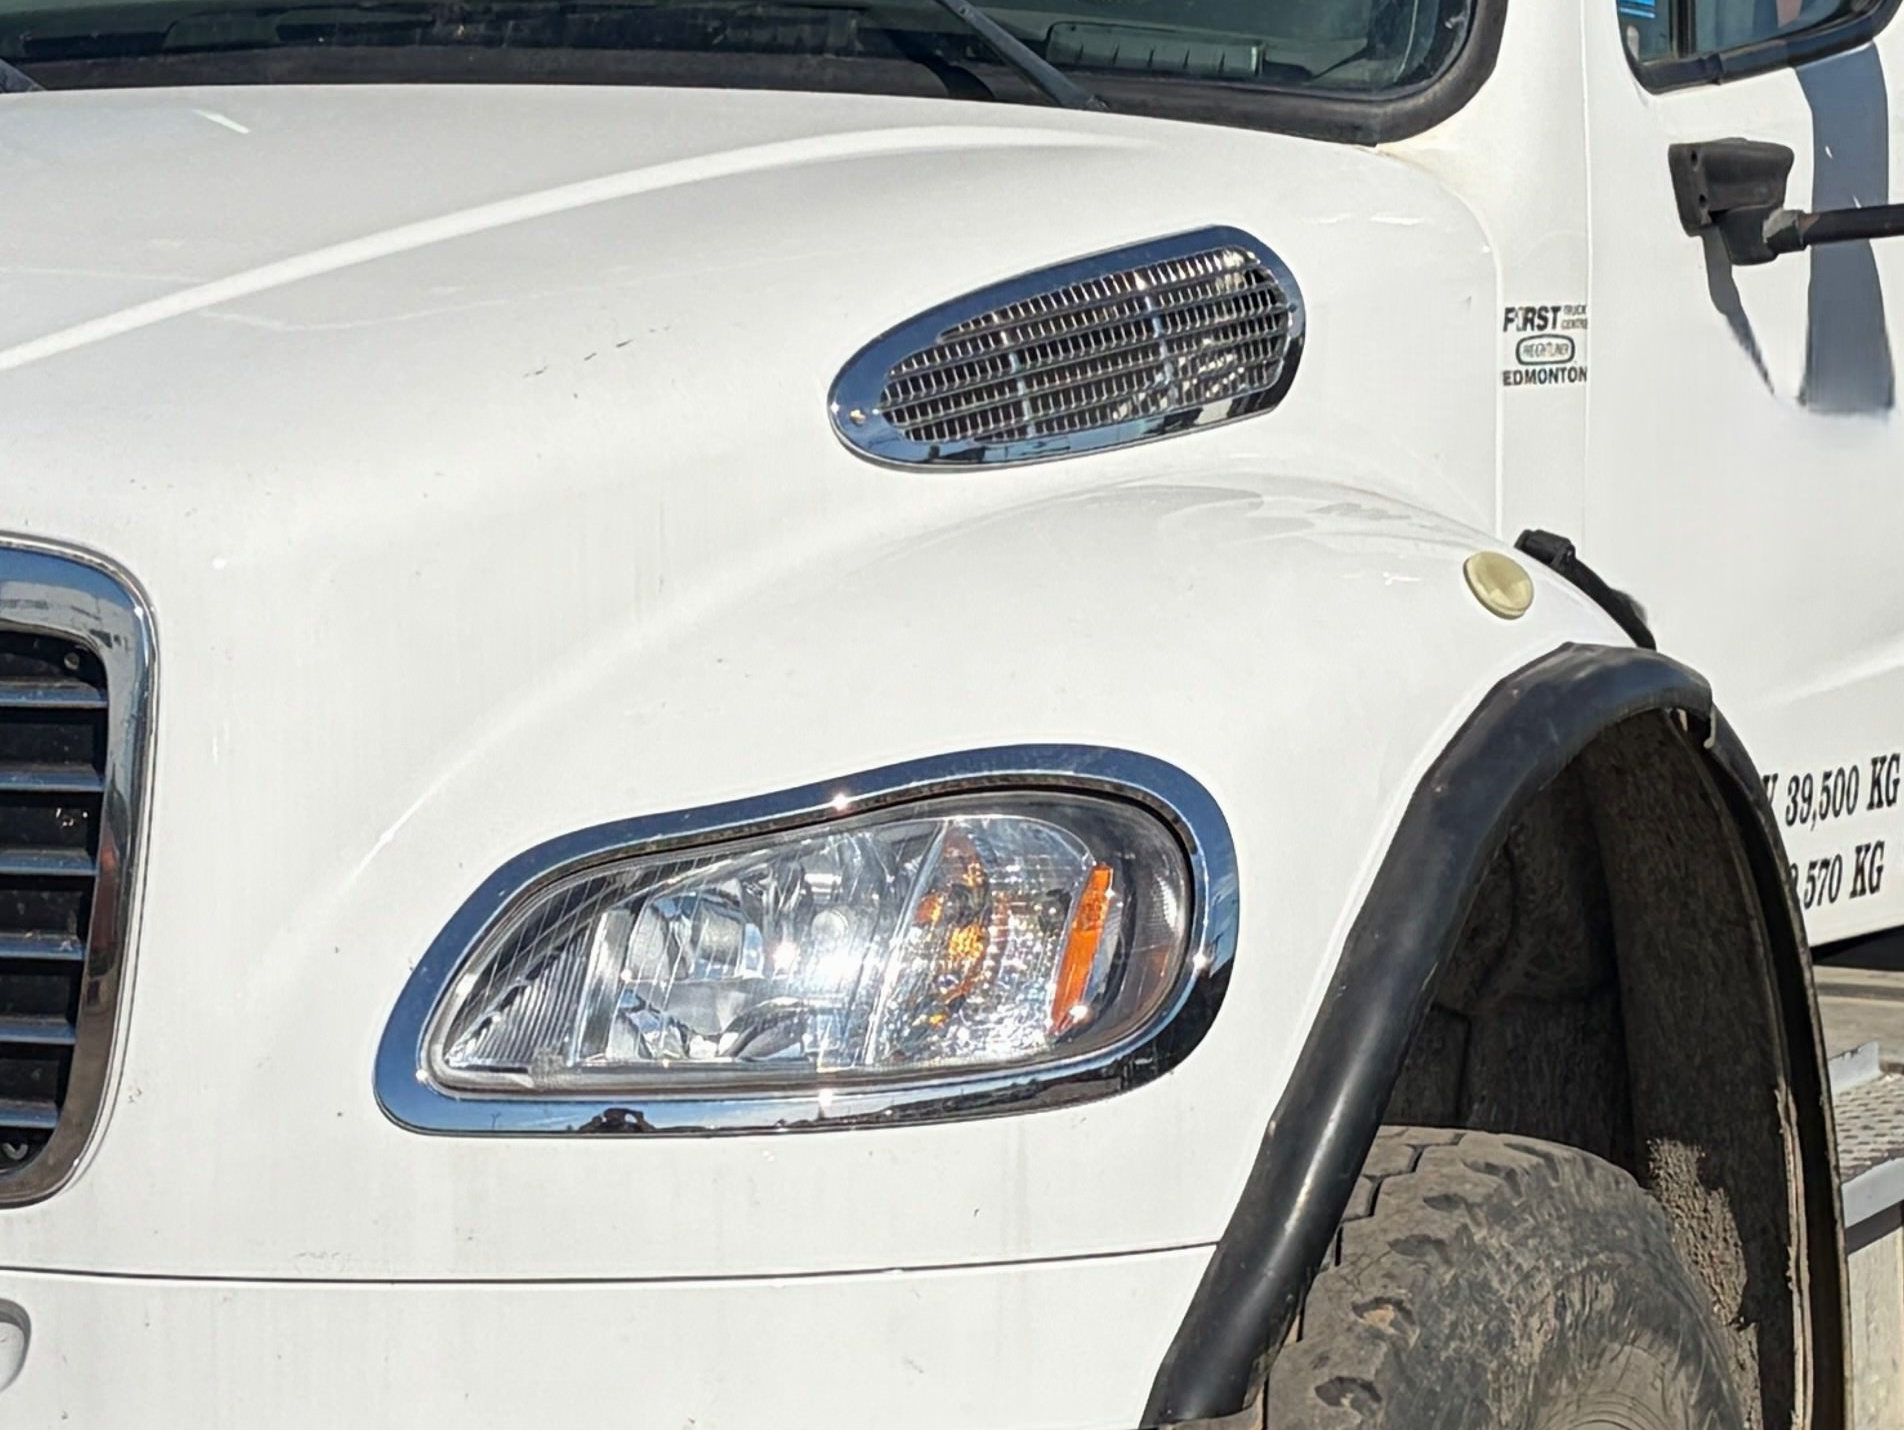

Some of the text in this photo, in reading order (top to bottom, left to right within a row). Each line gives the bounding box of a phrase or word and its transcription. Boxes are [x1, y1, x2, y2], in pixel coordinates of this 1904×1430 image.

[1503, 305, 1561, 332] FIRST
[1502, 366, 1587, 387] EDMONTON
[1785, 765, 1860, 832] 39,500
[1867, 753, 1901, 811] KG
[1849, 840, 1885, 899] KG
